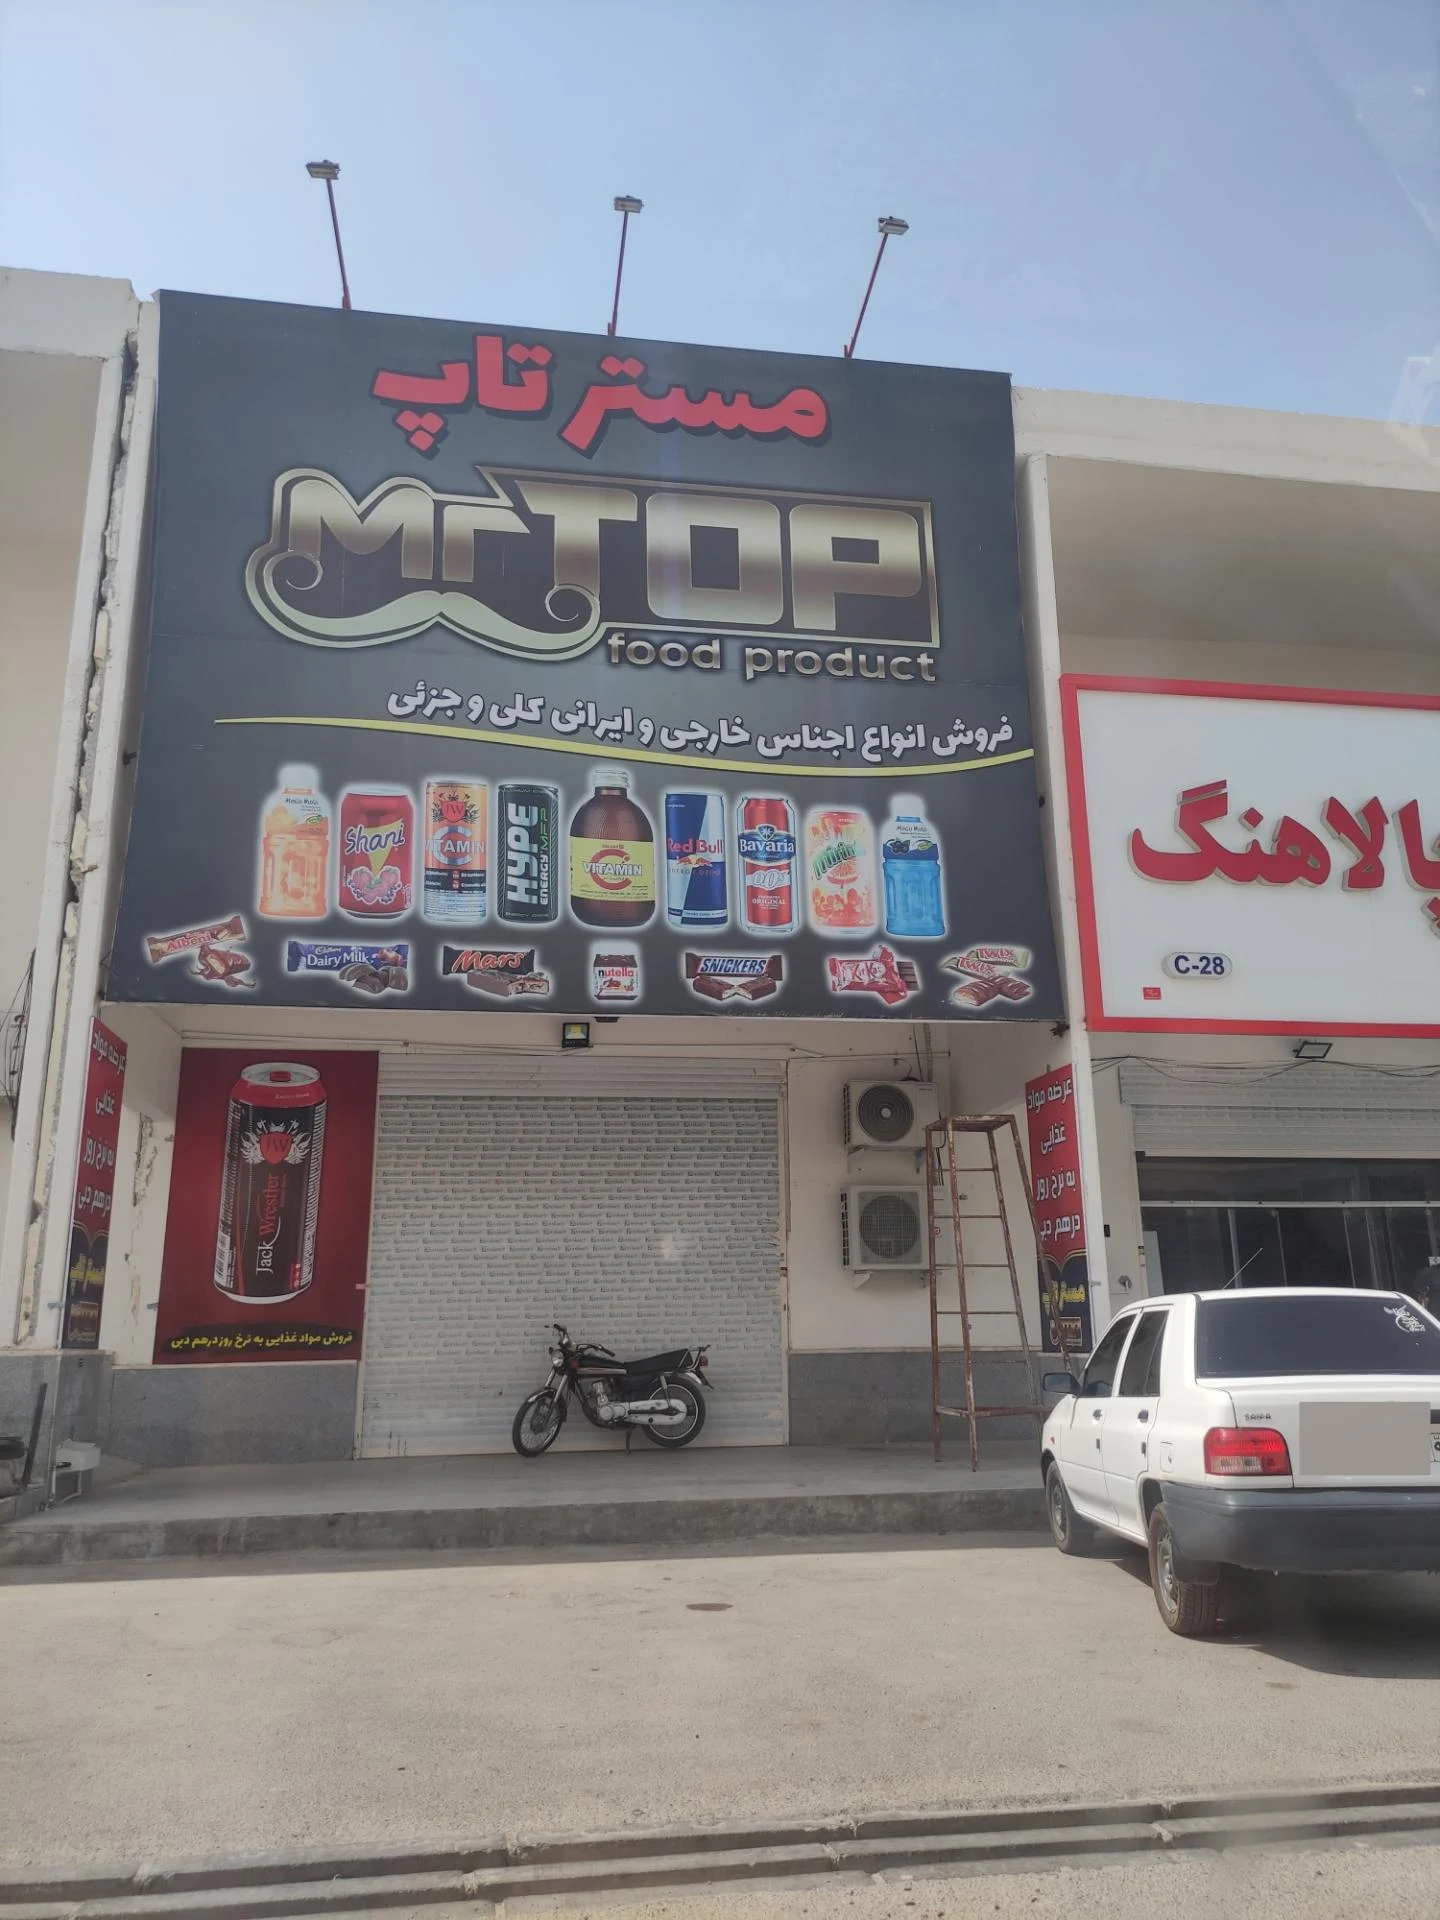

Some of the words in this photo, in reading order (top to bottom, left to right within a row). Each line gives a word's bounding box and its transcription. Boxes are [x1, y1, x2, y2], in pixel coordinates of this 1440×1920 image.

[373, 335, 553, 451] تاپ
[561, 355, 827, 450] مستر
[607, 632, 721, 669] food
[745, 647, 936, 682] product
[467, 694, 484, 723] و
[489, 692, 545, 727] کلی
[551, 700, 633, 741] ایرانی
[639, 717, 655, 745] و
[659, 715, 750, 753] خارجی
[757, 724, 854, 758] اجناس
[861, 723, 926, 763] انواع
[931, 714, 1013, 757] فروش
[345, 823, 405, 856] Shani
[696, 839, 723, 854] Bull
[740, 838, 795, 853] Bavaria
[582, 860, 643, 877] VITAMIN
[307, 953, 342, 967] Dairy
[343, 950, 370, 965] Milk
[452, 950, 524, 973] Mars
[598, 965, 634, 977] nutella
[701, 957, 767, 975] SNICKERS
[1174, 954, 1225, 976] C-28
[258, 1173, 281, 1237] Wrestler
[255, 1240, 276, 1275] Jack
[171, 1336, 190, 1349] دبی
[235, 1333, 251, 1349] نرخ
[265, 1331, 297, 1348] غذایی
[299, 1333, 321, 1346] مواد
[323, 1331, 353, 1346] فروش
